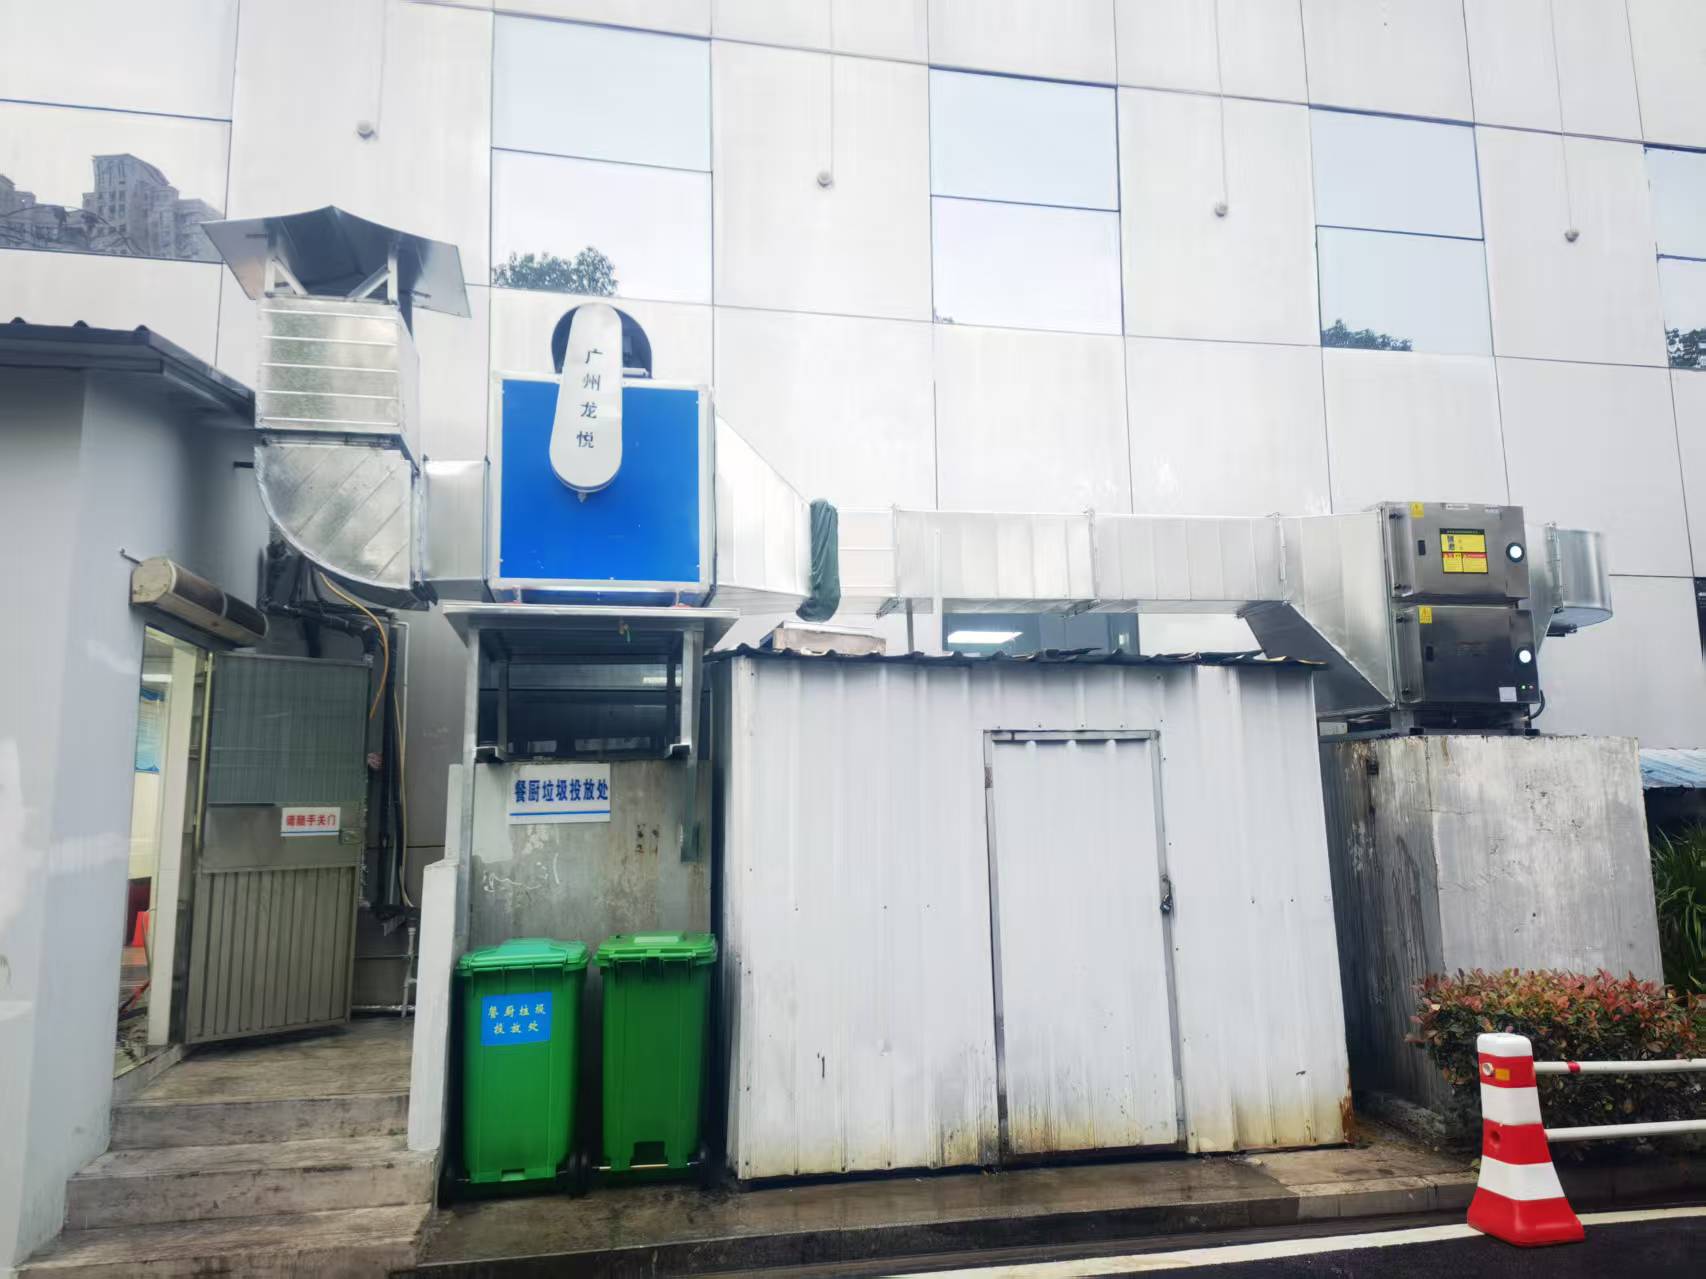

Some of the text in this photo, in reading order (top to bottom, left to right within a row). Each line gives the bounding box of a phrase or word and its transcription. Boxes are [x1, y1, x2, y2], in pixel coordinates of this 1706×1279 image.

[576, 348, 604, 448] 广州龙悦
[514, 778, 609, 803] 餐厨垃圾投放处
